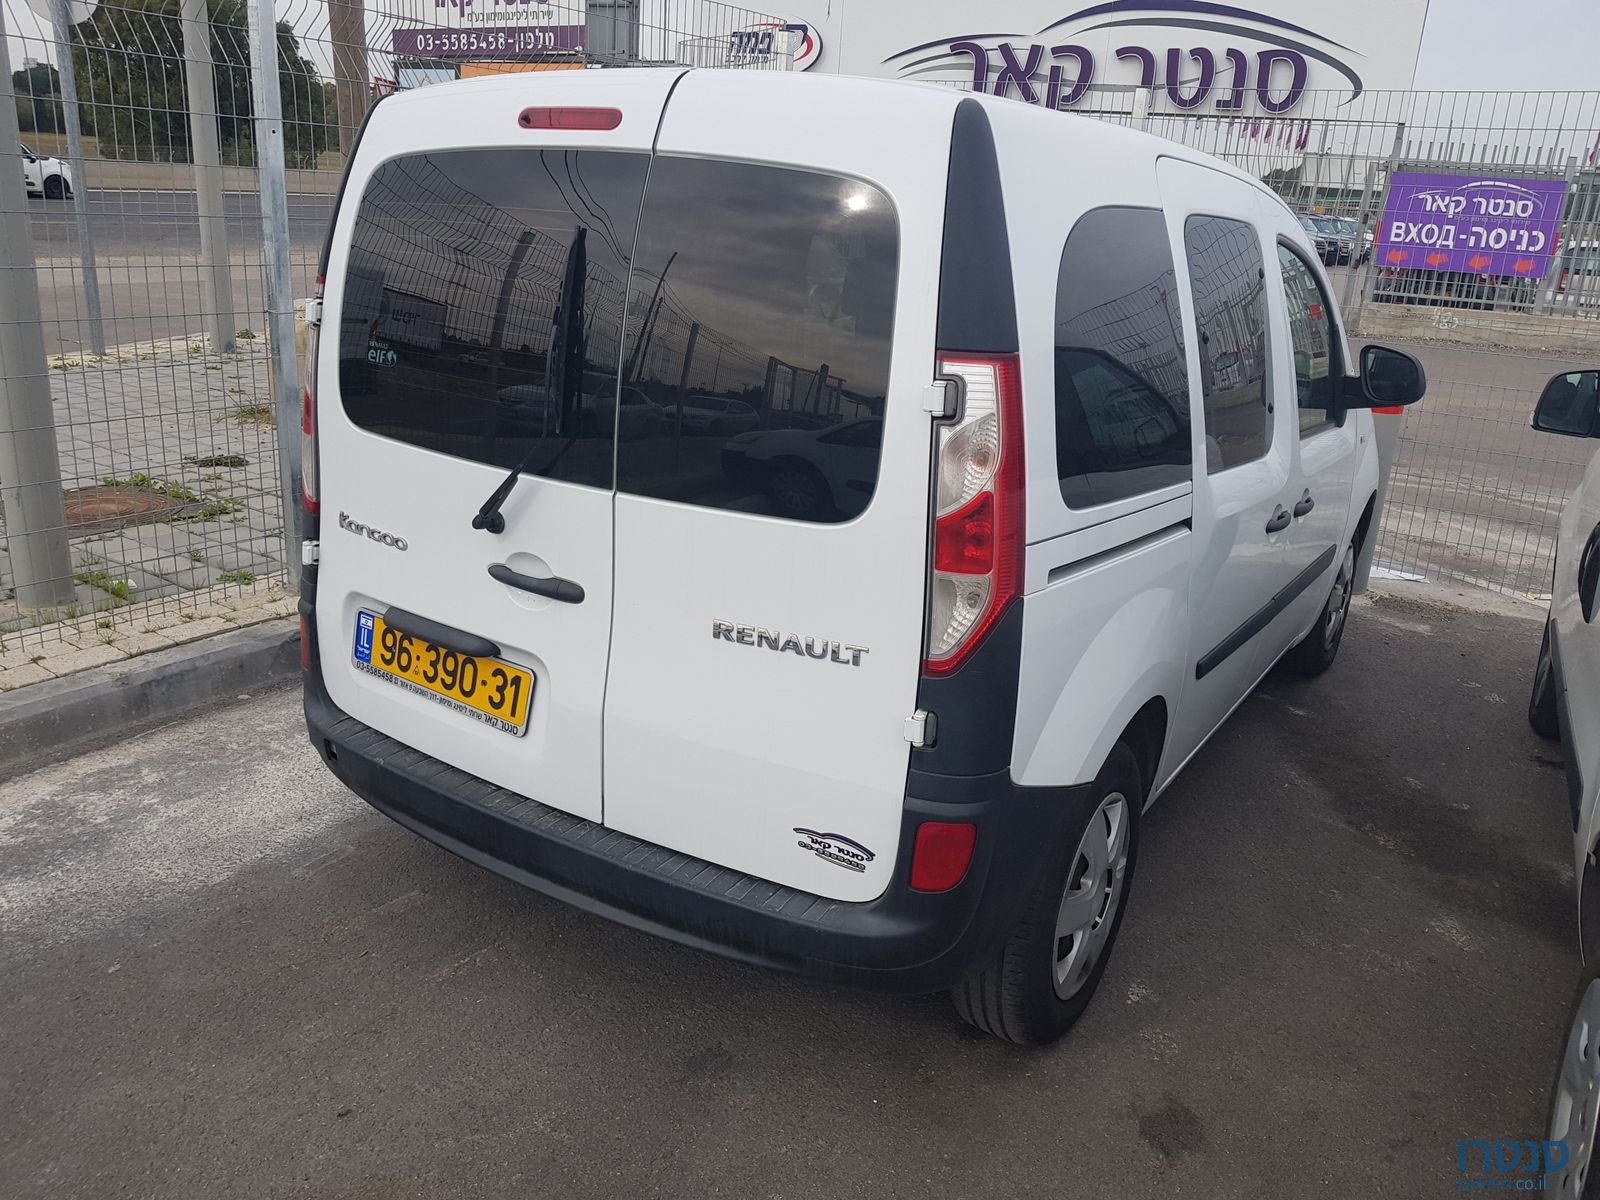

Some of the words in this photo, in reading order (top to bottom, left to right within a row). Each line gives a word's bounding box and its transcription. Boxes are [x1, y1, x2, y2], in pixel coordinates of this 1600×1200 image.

[530, 10, 553, 20] שירתי
[949, 41, 1096, 111] קאר
[1116, 45, 1309, 114] סנטר
[1419, 193, 1467, 218] קאר
[1473, 195, 1534, 218] סנטר
[359, 627, 370, 648] IL
[712, 618, 870, 667] RENAULT
[483, 713, 499, 728] קאר
[499, 719, 519, 736] סנטר
[807, 835, 832, 850] קאר
[834, 845, 865, 862] סנטר
